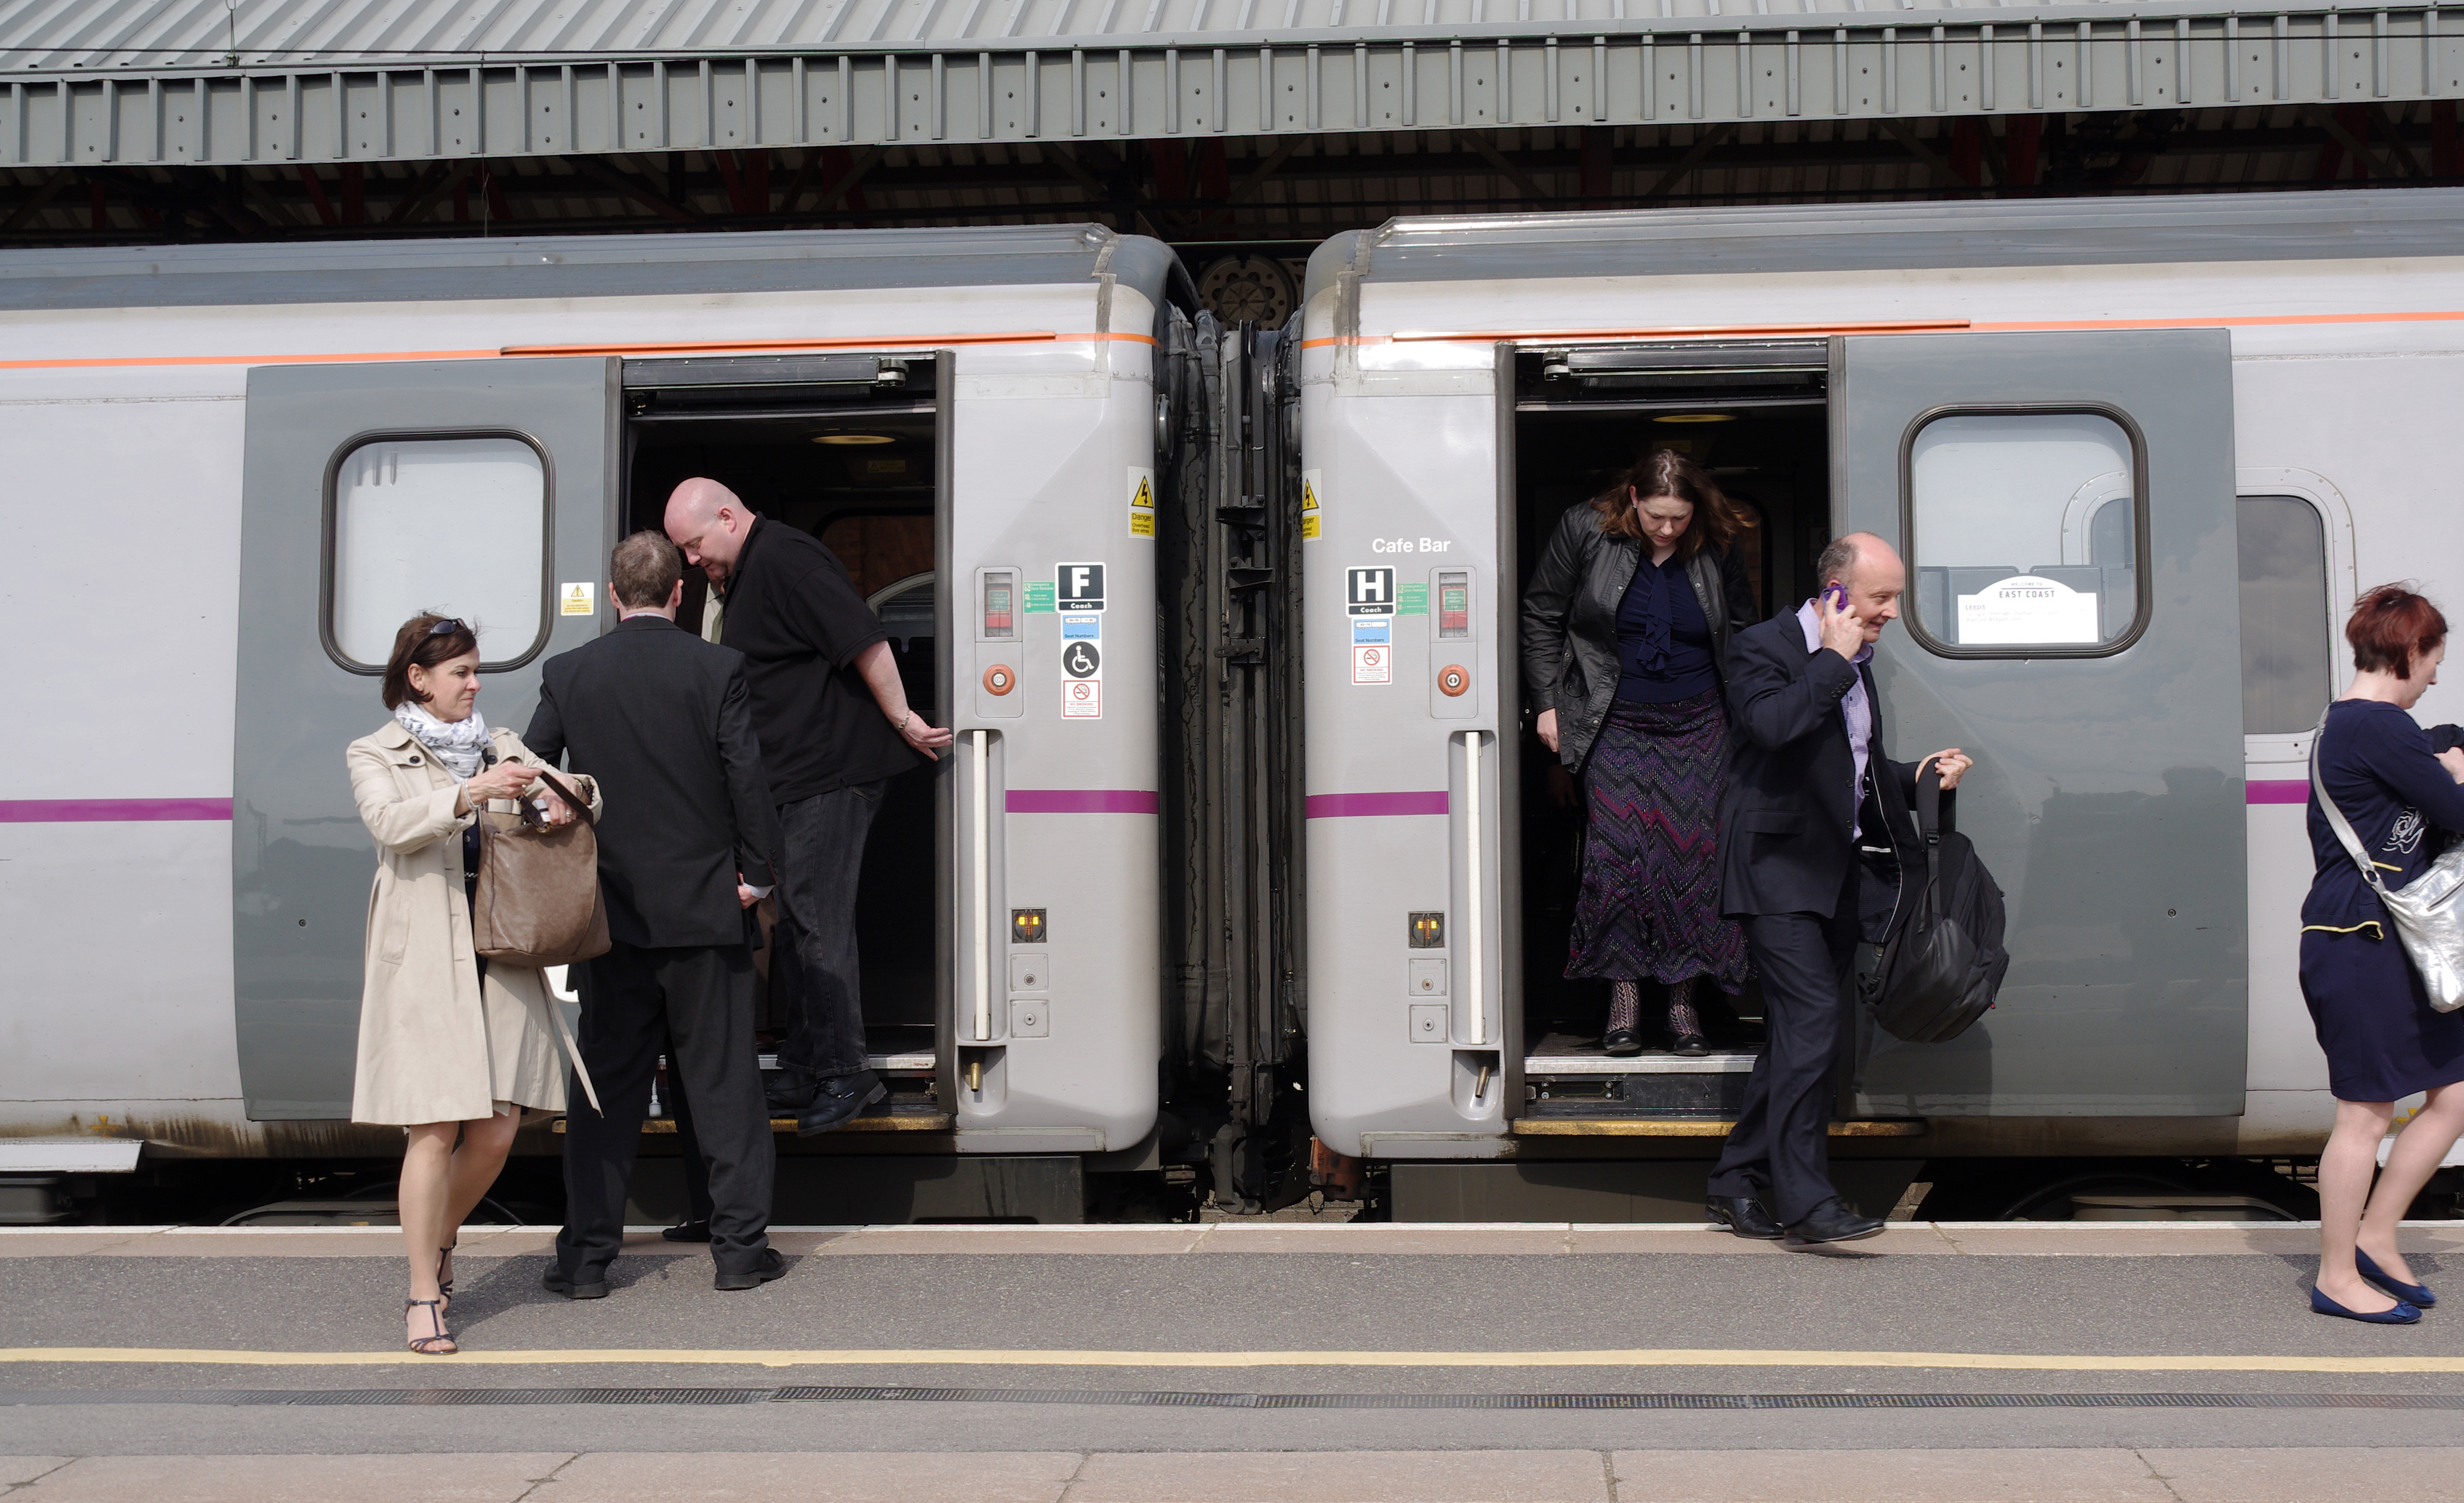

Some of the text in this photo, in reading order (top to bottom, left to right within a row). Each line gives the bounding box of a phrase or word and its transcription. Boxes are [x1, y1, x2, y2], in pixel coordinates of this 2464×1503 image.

[1132, 513, 1152, 522] Danger
[1372, 537, 1451, 553] Cafe Bar
[1071, 567, 1090, 598] F
[1357, 571, 1384, 602] H
